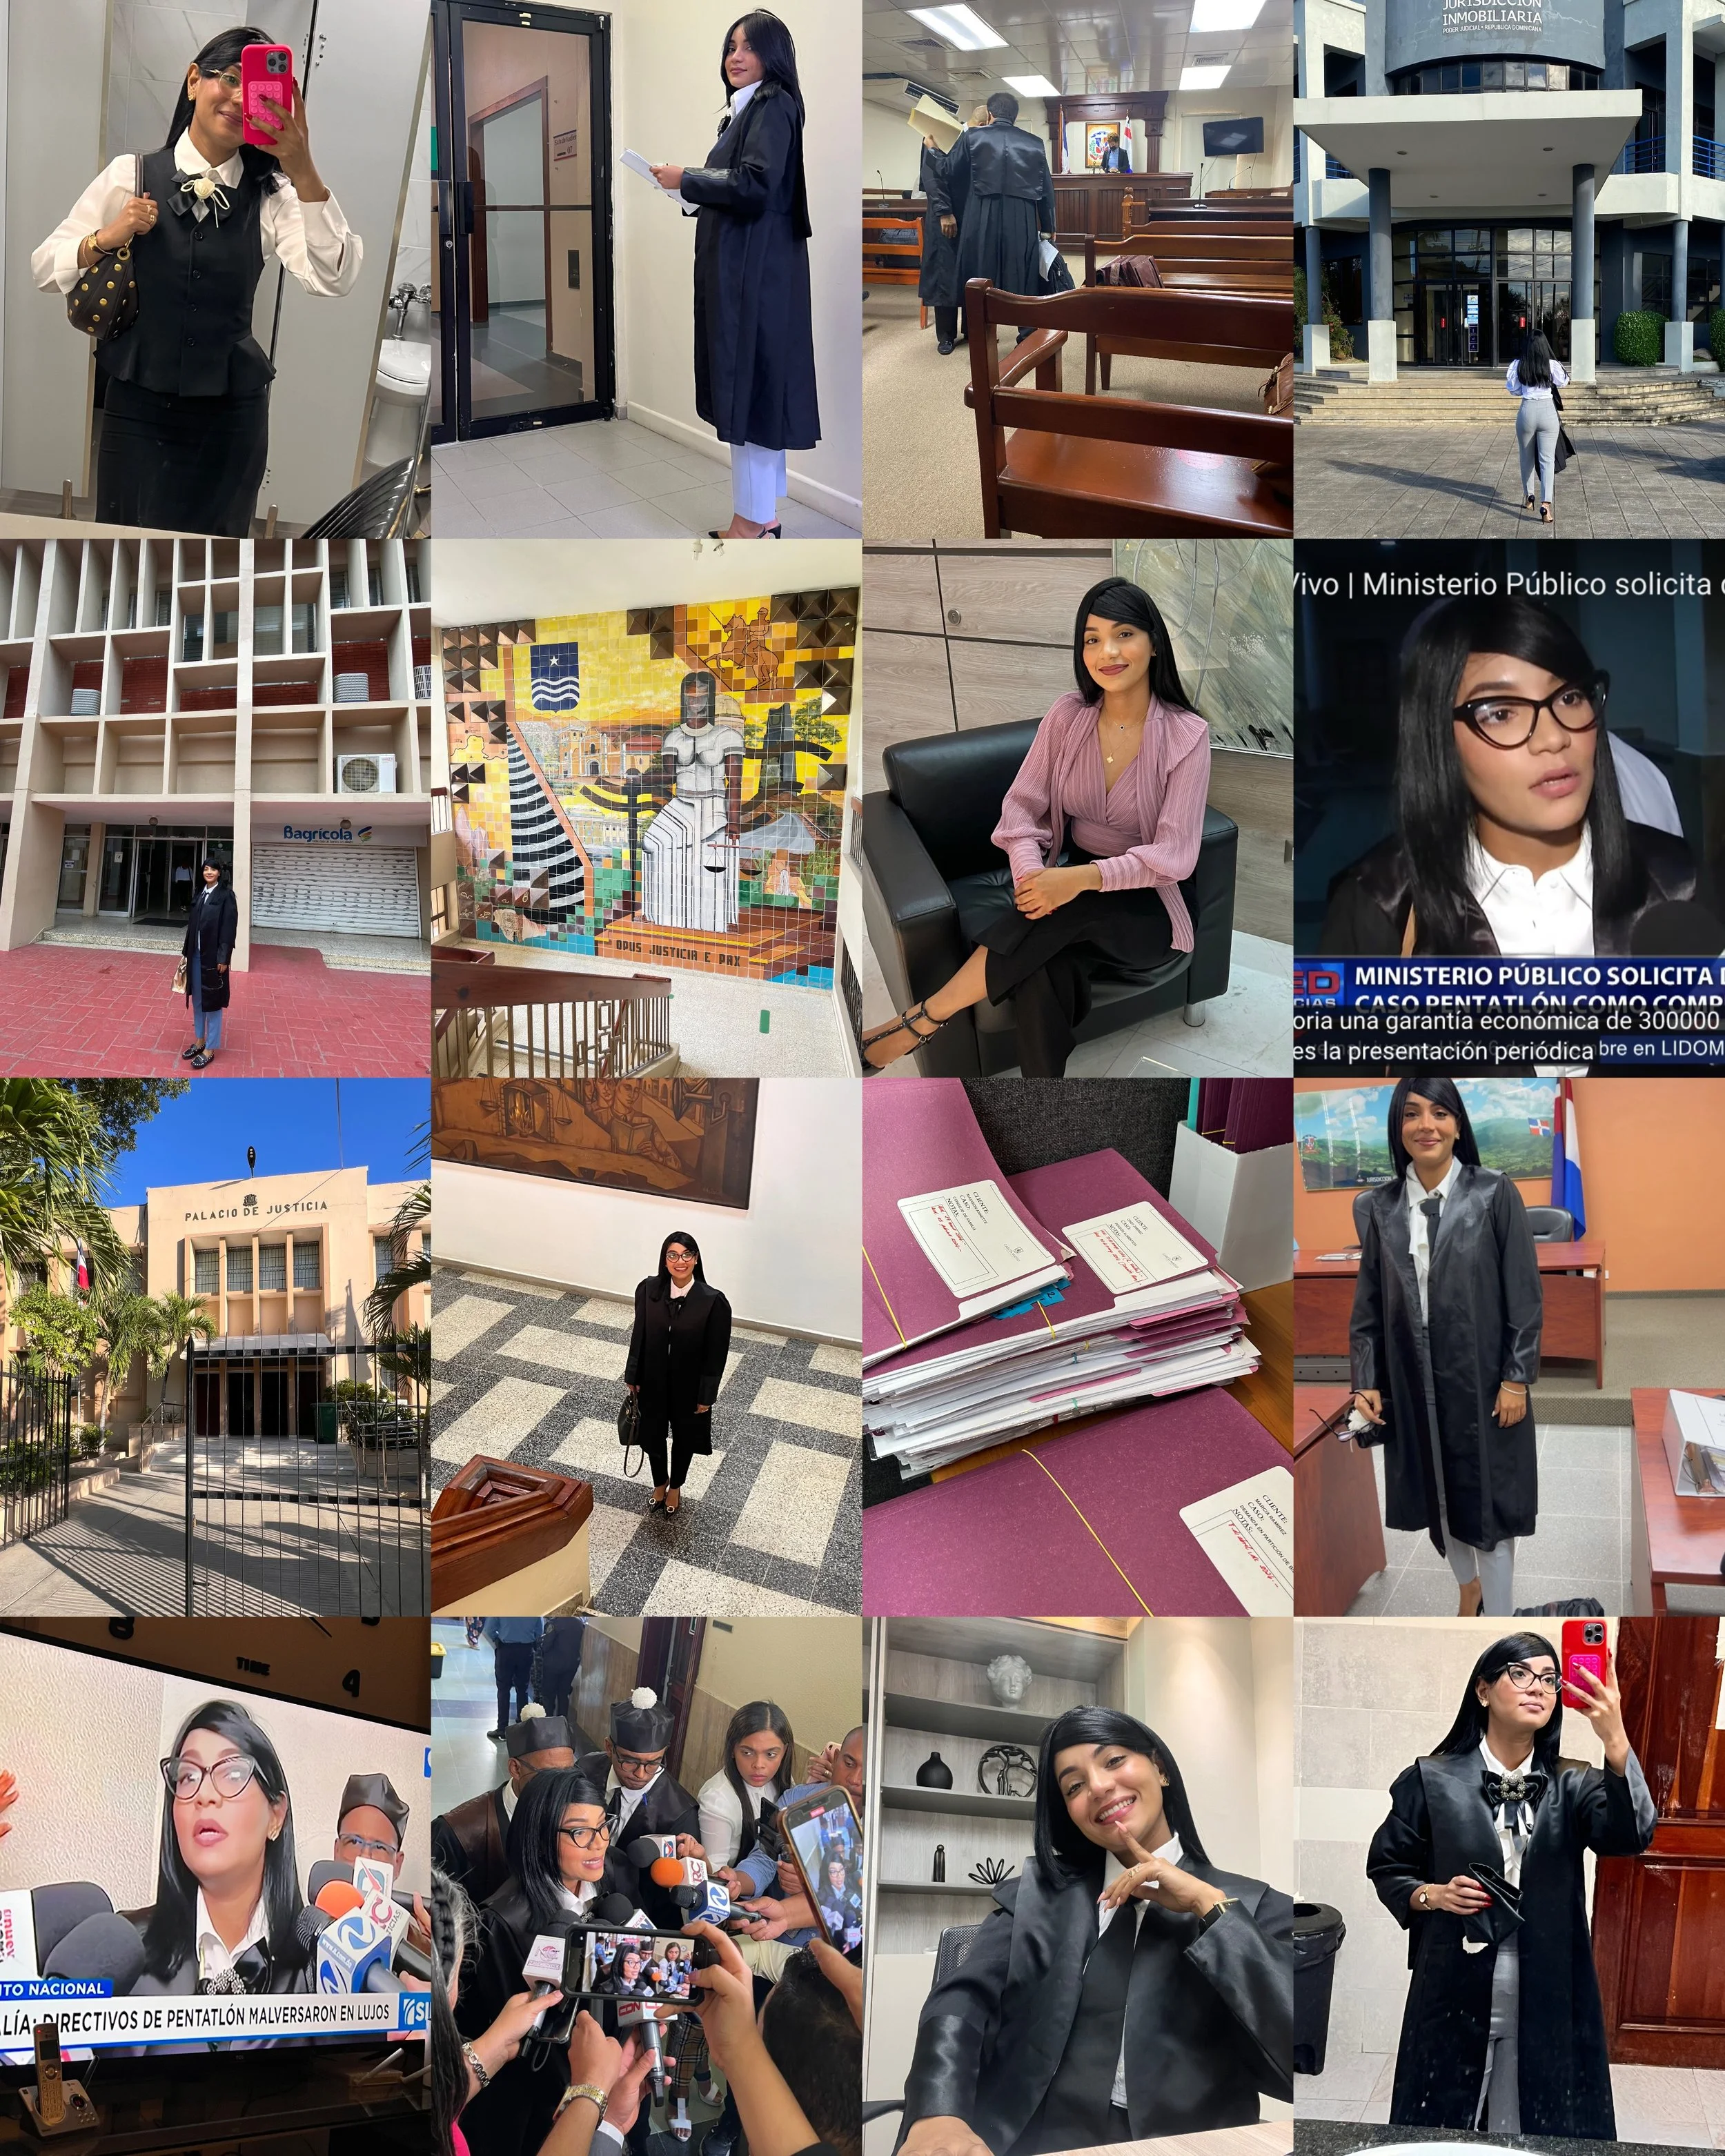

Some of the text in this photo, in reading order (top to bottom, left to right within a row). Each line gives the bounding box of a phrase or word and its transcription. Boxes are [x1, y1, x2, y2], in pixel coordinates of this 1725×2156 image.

[1443, 10, 1542, 26] INMOBILIARIA
[284, 825, 353, 842] Bagrícola
[616, 940, 740, 967] OPUS JUSTICIA E PAX
[185, 1200, 328, 1221] PALACIO DE JUSTICIA
[946, 1198, 960, 1217] NOTAS:
[960, 1194, 971, 1210] CASO:
[973, 1191, 989, 1214] CLIENTE:
[1109, 1224, 1121, 1237] NOTAS:
[1121, 1220, 1131, 1230] CASO:
[1132, 1216, 1148, 1231] CLIENTE:
[1248, 1501, 1265, 1521] CASO:
[1255, 1499, 1287, 1536] MARCIA RAMIREZ
[1262, 1494, 1288, 1523] CLIENTE:
[1233, 1509, 1253, 1533] NOTAS:
[1240, 1505, 1258, 1527] DEMANDA
[1262, 1533, 1283, 1559] PARTICIÓN
[1282, 1557, 1290, 1565] DE
[236, 1656, 361, 1697] TIME 4
[28, 1983, 104, 1996] NACIONAL
[415, 2001, 431, 2021] SI
[618, 2001, 641, 2016] CDN
[0, 2009, 36, 2035] LÍA:
[144, 2010, 162, 2028] DE
[167, 2003, 245, 2028] PENTATLÓN
[249, 2006, 337, 2024] MALVERSARON
[340, 2006, 355, 2021] EN
[357, 2004, 389, 2020] LUJOS
